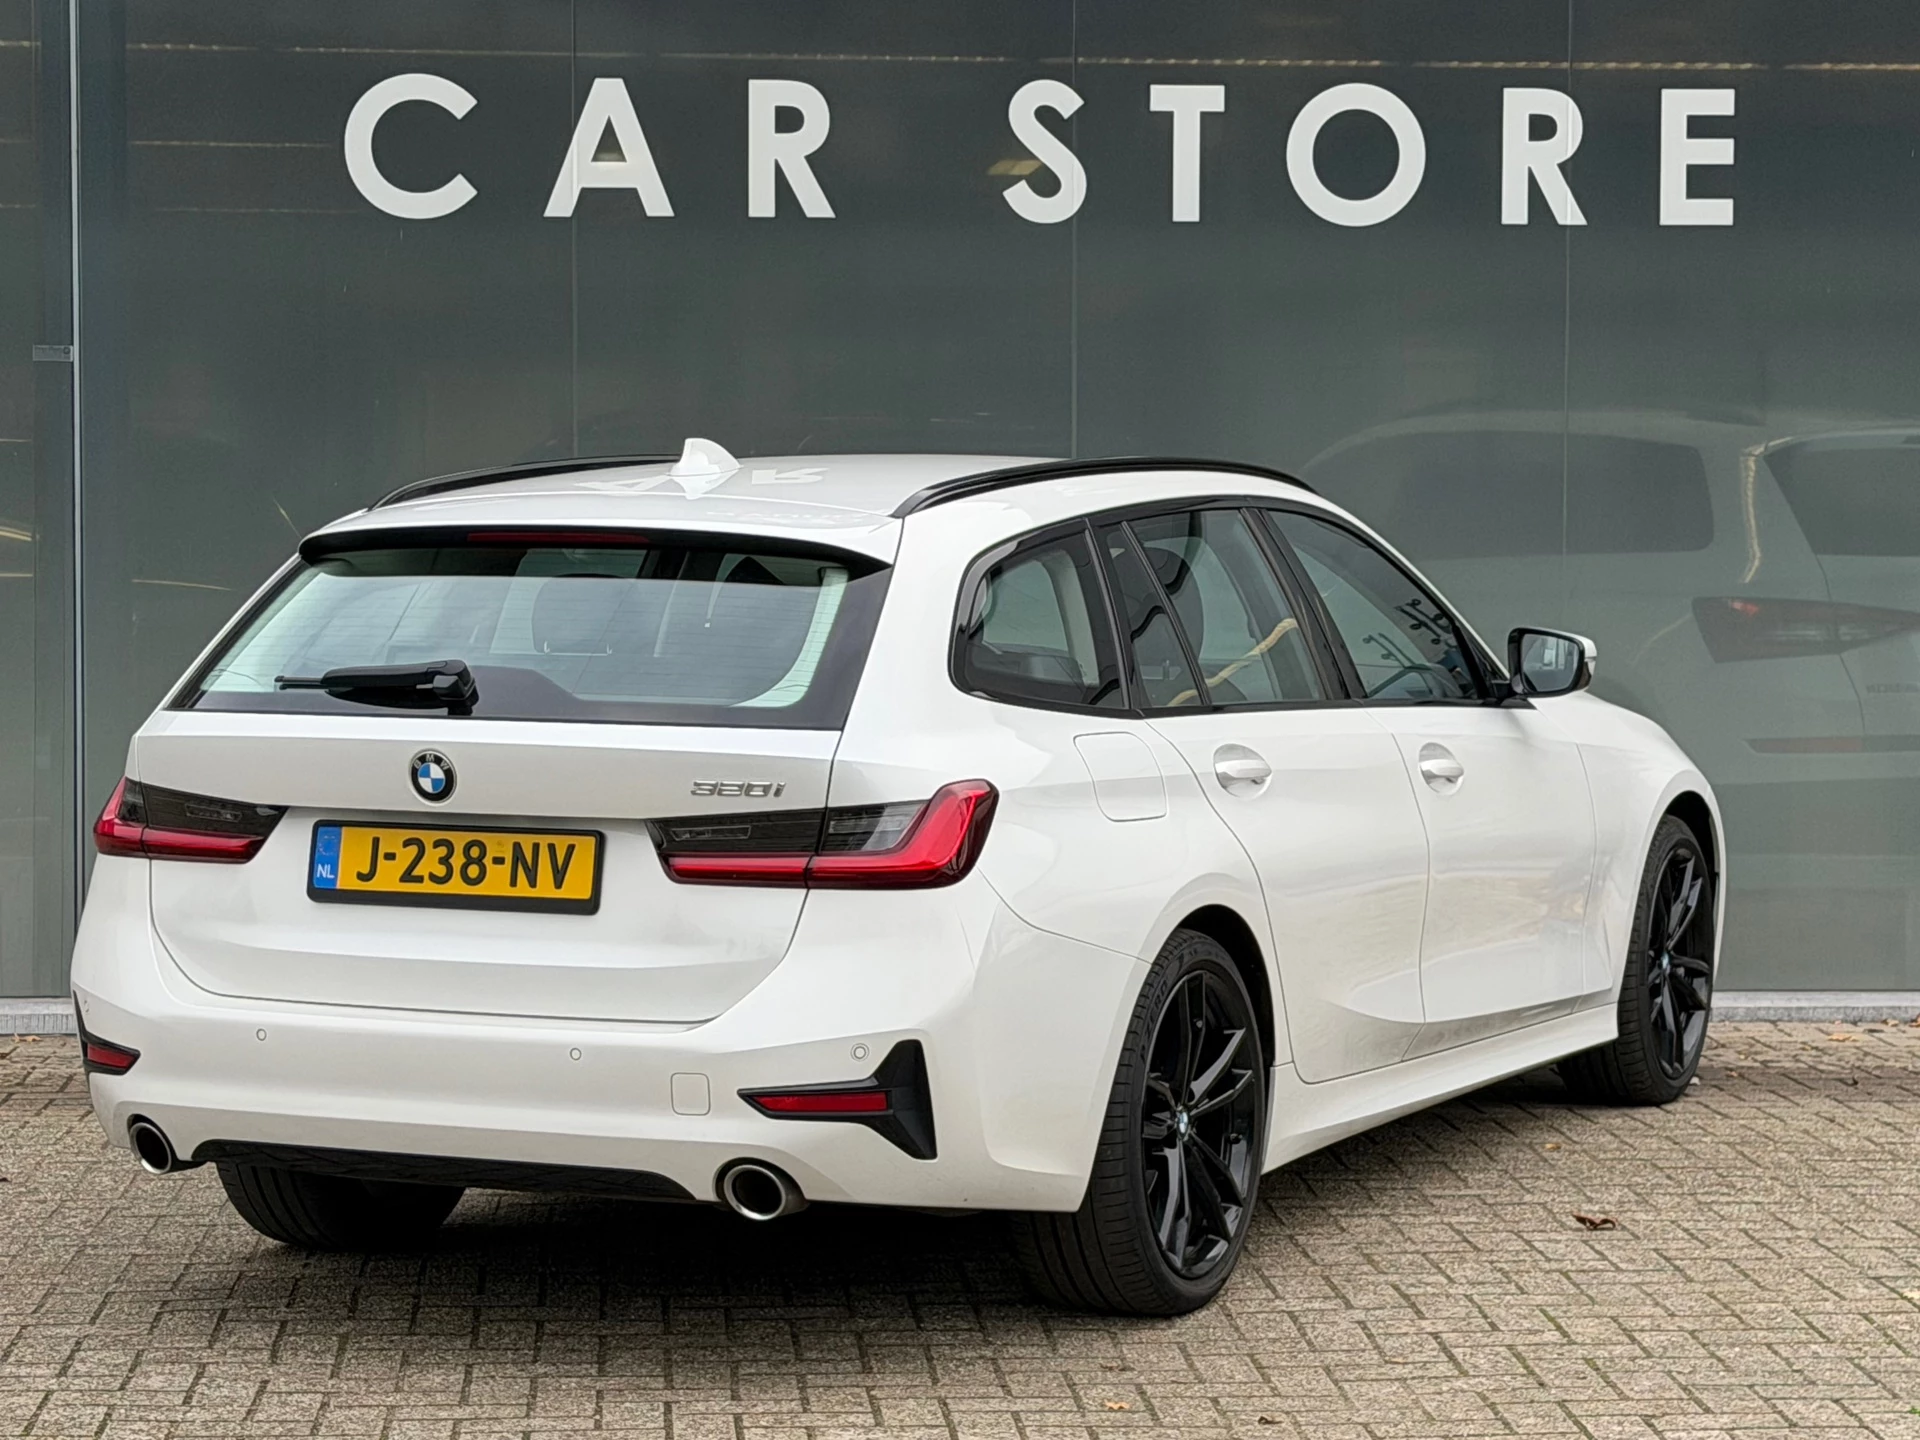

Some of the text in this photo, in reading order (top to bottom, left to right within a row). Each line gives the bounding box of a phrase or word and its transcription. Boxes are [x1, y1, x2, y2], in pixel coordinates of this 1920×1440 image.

[344, 73, 1736, 228] CAR STORE
[413, 753, 450, 770] BMW
[690, 780, 786, 797] 320i
[316, 863, 335, 879] NL
[356, 836, 576, 890] J-238-NV
